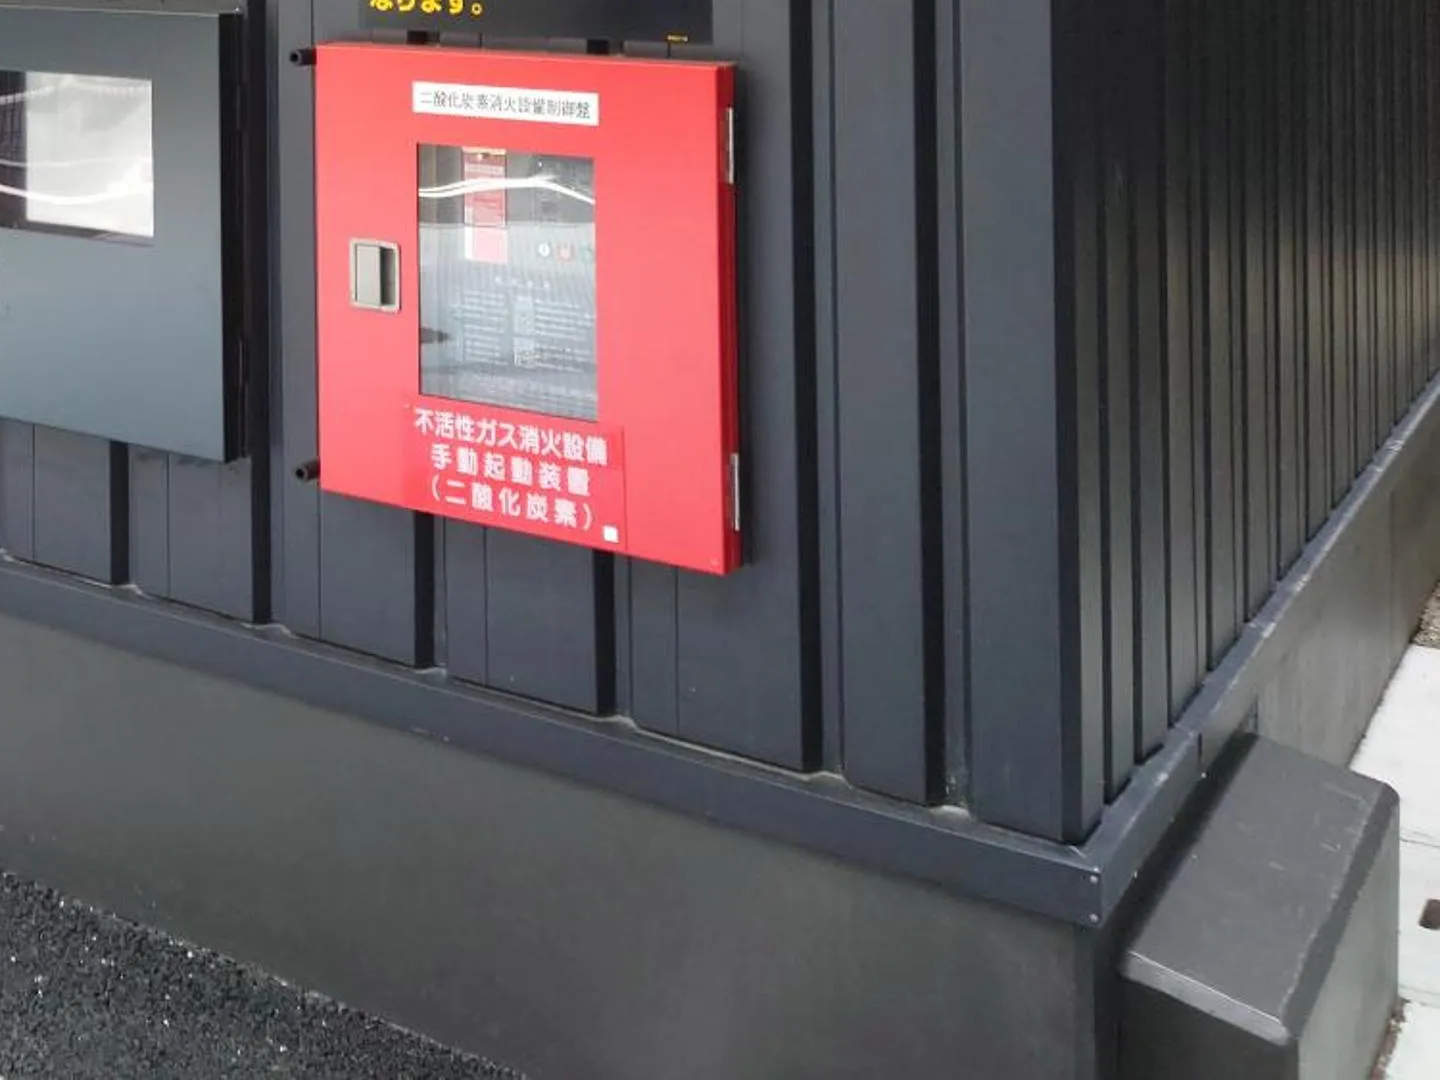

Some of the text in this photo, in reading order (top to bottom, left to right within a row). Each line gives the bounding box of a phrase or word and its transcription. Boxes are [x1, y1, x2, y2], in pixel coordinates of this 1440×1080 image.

[414, 407, 608, 467] 不活性ガス消火設備
[431, 443, 591, 497] 手動起動装置
[431, 474, 594, 531] （二酸化炭素）
